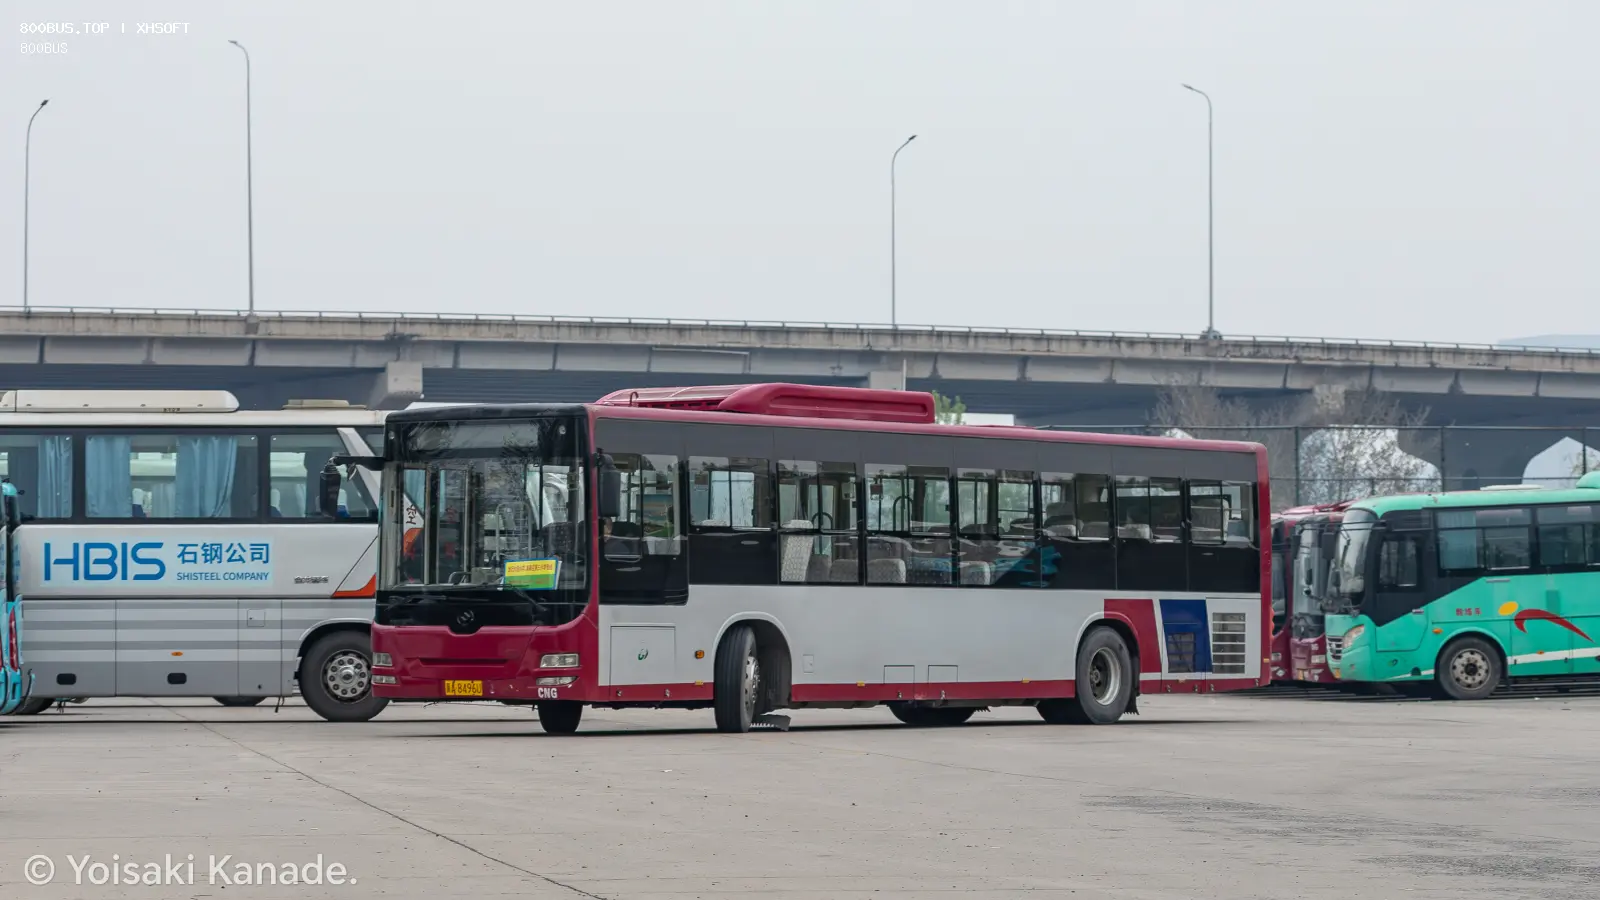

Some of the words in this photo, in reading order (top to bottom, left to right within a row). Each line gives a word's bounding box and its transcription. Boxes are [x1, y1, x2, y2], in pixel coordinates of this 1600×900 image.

[44, 542, 166, 581] HBIS
[177, 542, 270, 564] 石钢公司
[177, 571, 221, 581] SHISTEEL
[222, 571, 269, 581] COMPANY
[537, 687, 558, 699] CNG
